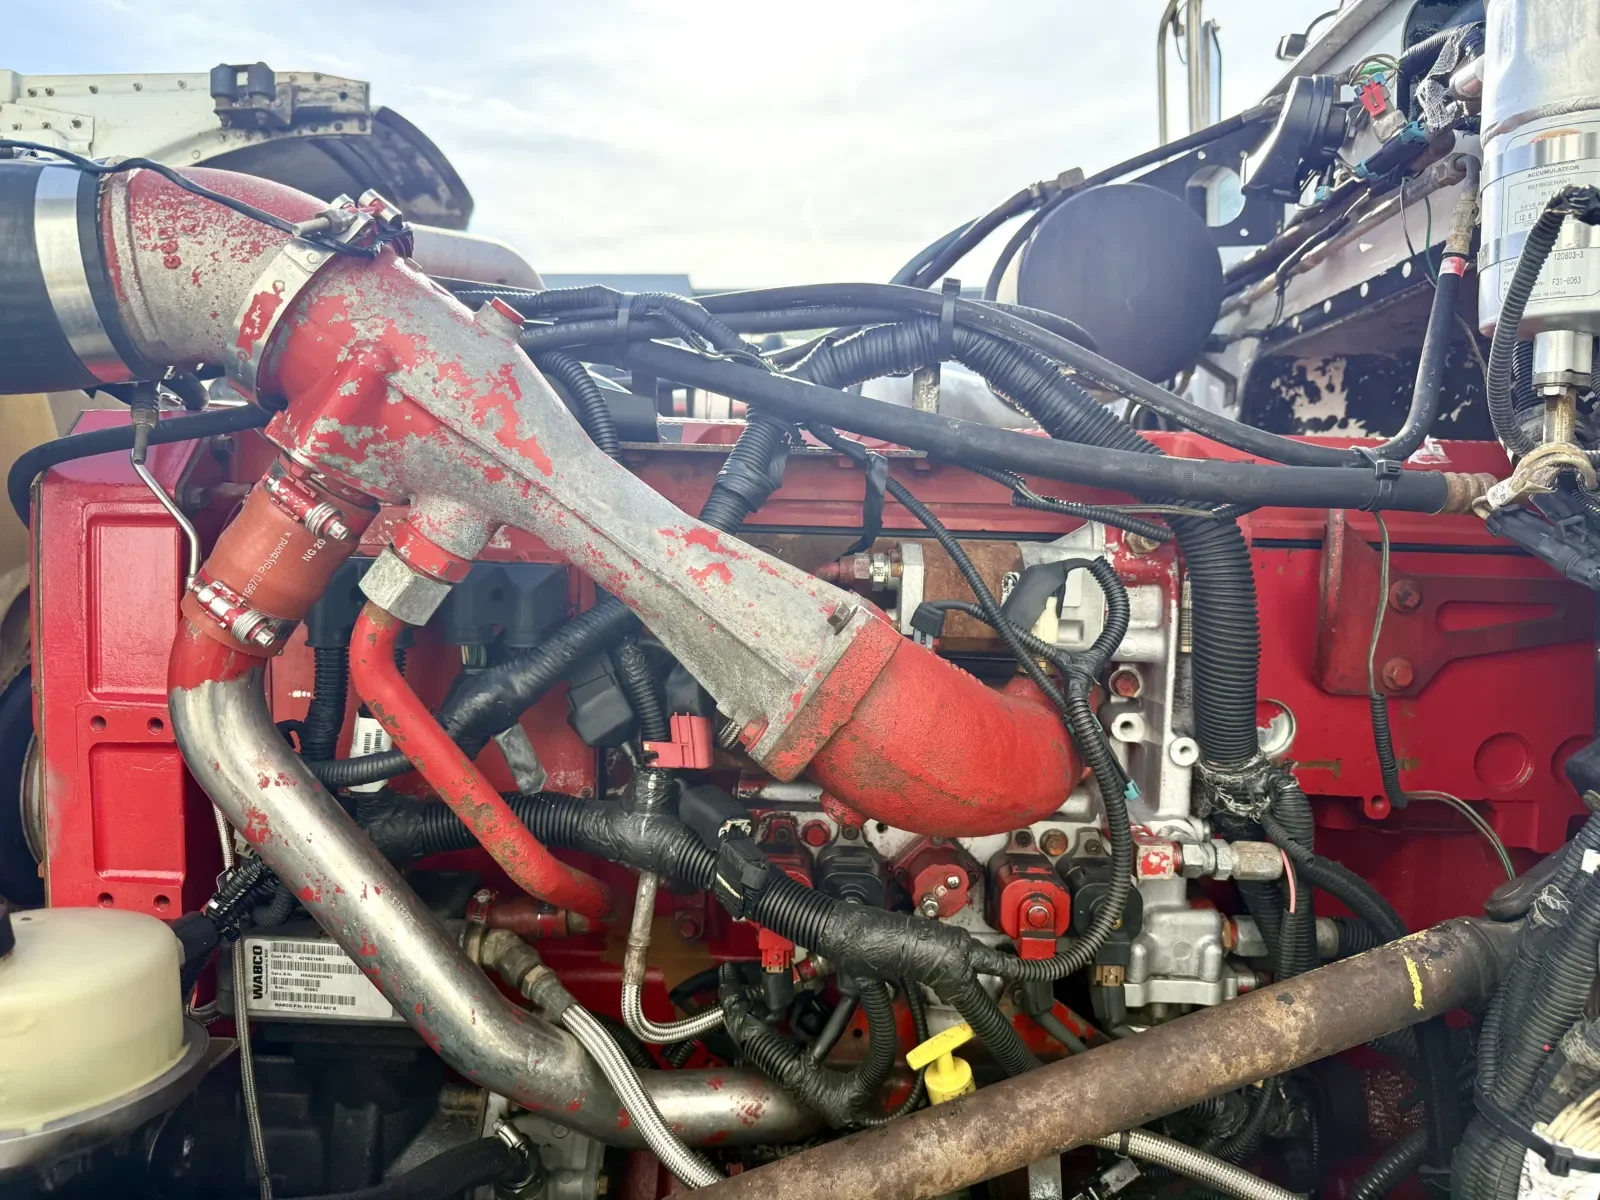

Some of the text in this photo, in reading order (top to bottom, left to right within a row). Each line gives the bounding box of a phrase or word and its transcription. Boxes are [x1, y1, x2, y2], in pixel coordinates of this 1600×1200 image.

[1554, 251, 1584, 260] 120803-3
[257, 536, 289, 574] Polybond
[301, 538, 326, 562] NG 20
[252, 945, 263, 1000] WABCO
